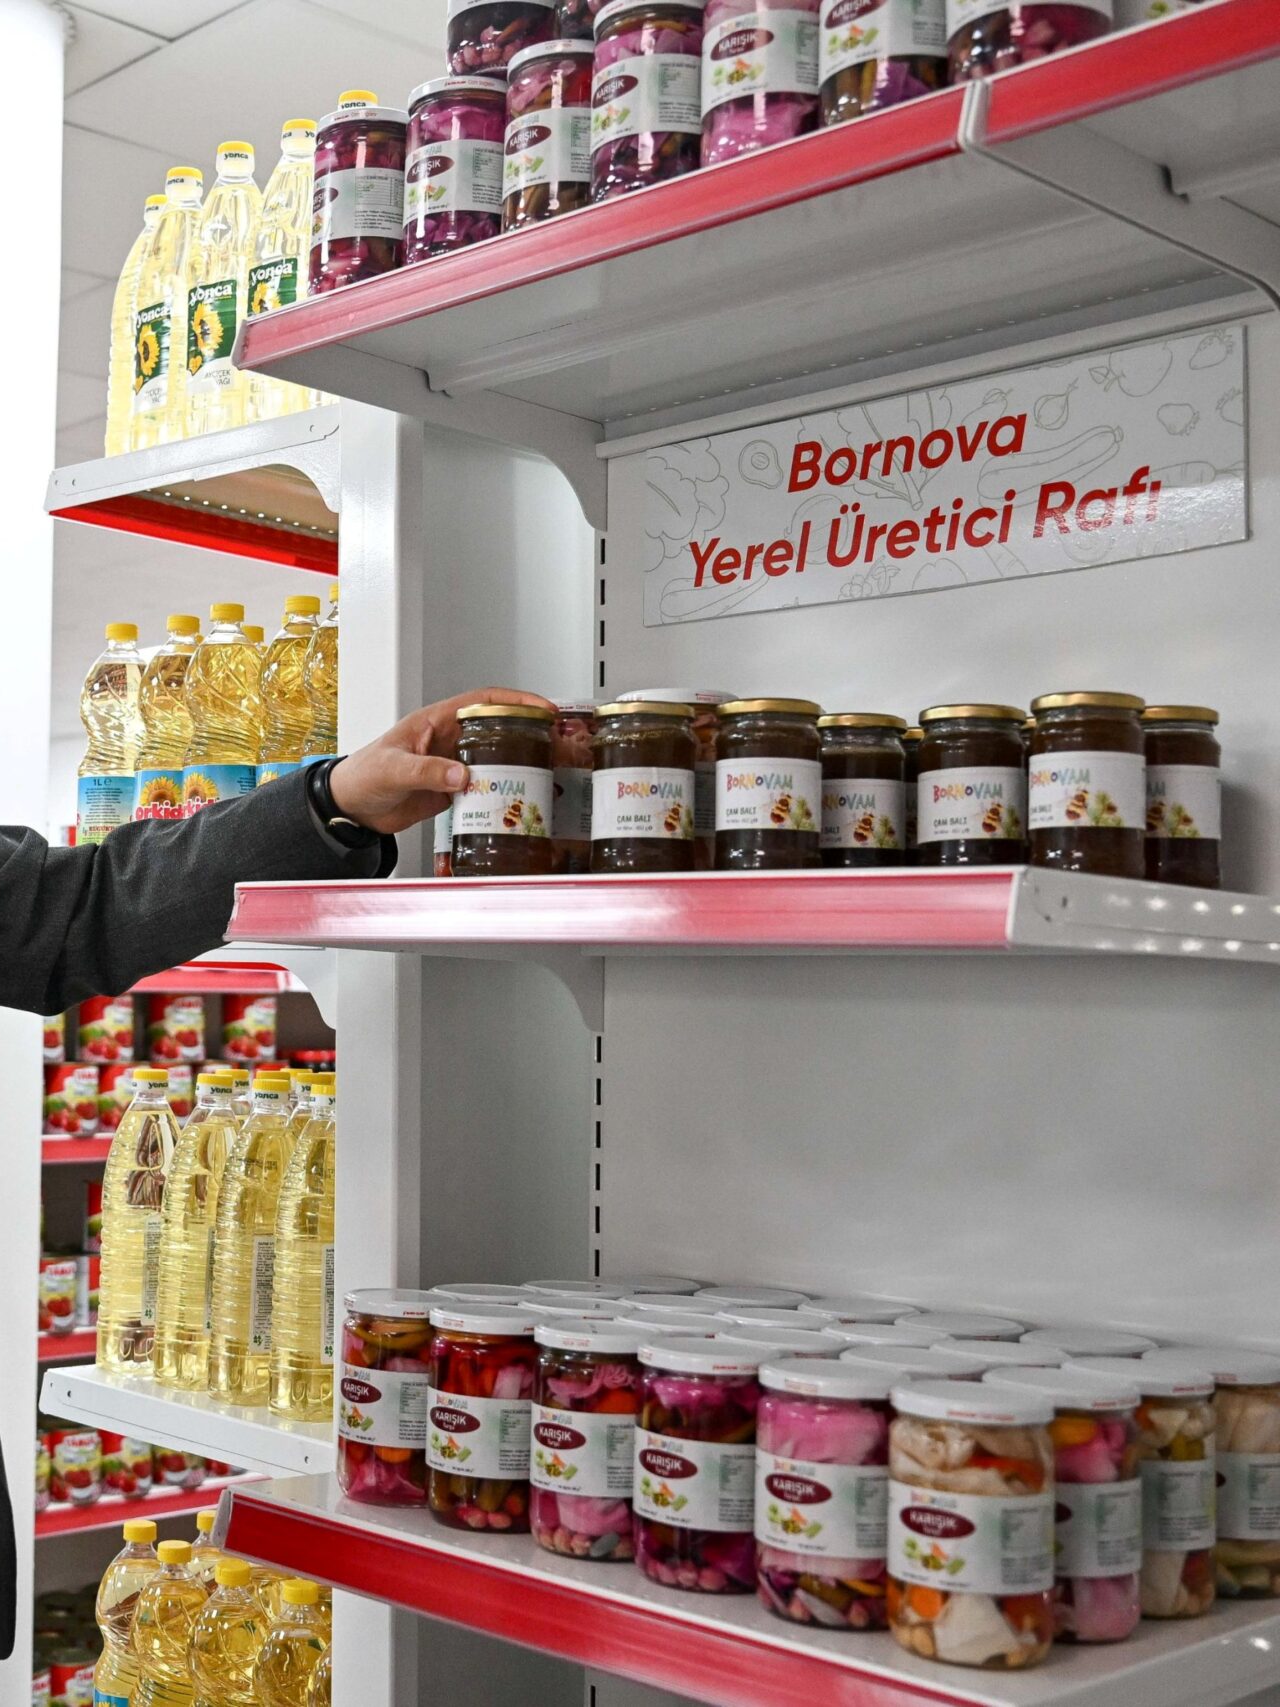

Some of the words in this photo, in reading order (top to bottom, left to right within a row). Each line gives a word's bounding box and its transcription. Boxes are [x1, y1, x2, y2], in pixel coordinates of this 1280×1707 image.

[224, 152, 248, 160] yonca
[412, 159, 441, 176] KAŞIK
[190, 283, 232, 304] yonca
[136, 304, 167, 328] yonca
[786, 413, 1027, 494] Bornova
[688, 520, 811, 588] Yerel
[826, 489, 1017, 569] Üretici
[1031, 465, 1162, 540] Rafı
[93, 778, 102, 786] 1L
[617, 781, 682, 799] BORNOVAM
[727, 772, 793, 792] BORNOVAM
[933, 783, 1003, 803] BORNOVAM
[135, 801, 183, 820] orkid
[634, 814, 651, 823] BALI
[148, 1082, 168, 1090] yonc
[210, 1086, 232, 1094] yonc
[254, 1091, 279, 1100] yonca
[344, 1382, 369, 1396] KARIŞIK
[435, 1410, 466, 1426] KARIŞIK
[540, 1426, 571, 1441] KARIŞIK
[646, 1452, 682, 1471] KARIŞIK
